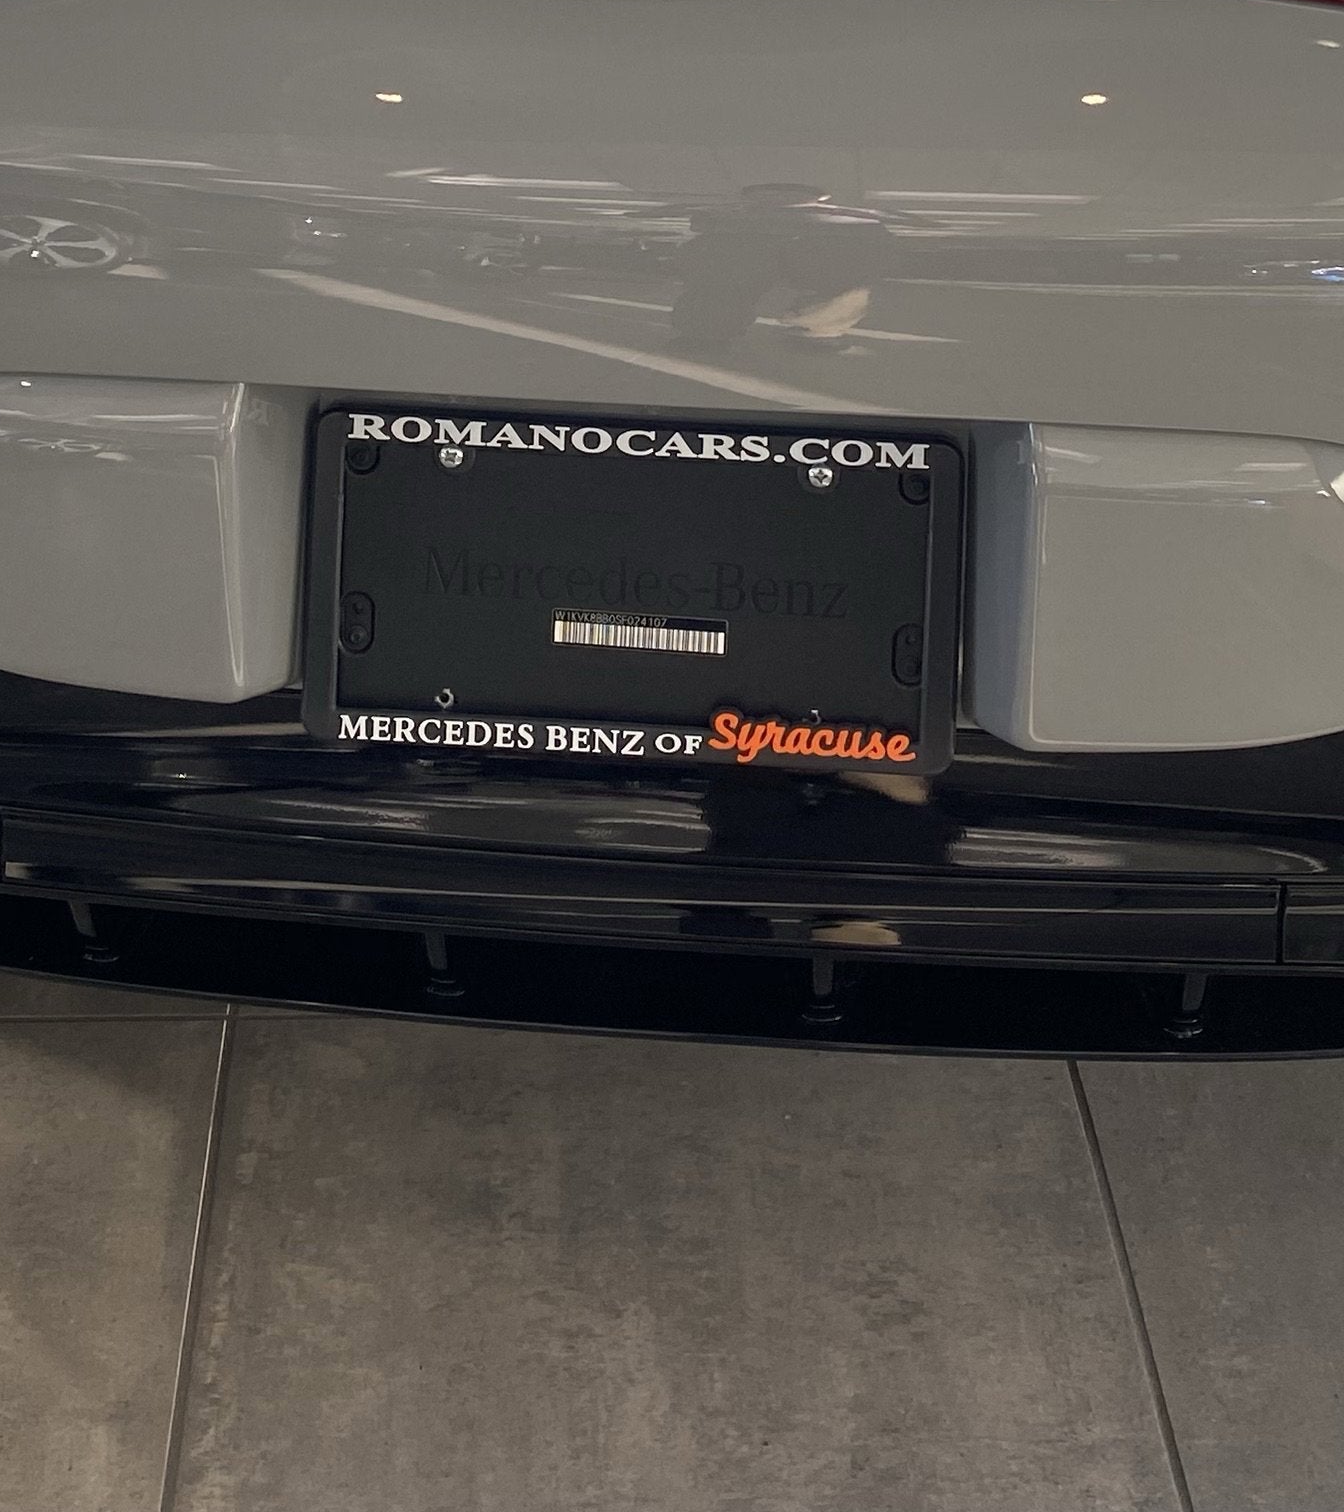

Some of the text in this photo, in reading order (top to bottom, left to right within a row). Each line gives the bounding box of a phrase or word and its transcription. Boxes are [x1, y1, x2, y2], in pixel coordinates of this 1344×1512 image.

[347, 413, 931, 470] ROMANOCARS.COM
[424, 544, 848, 619] Mercedes-Benz
[338, 711, 917, 764] MERCEDES BENZ OF Syracuse
